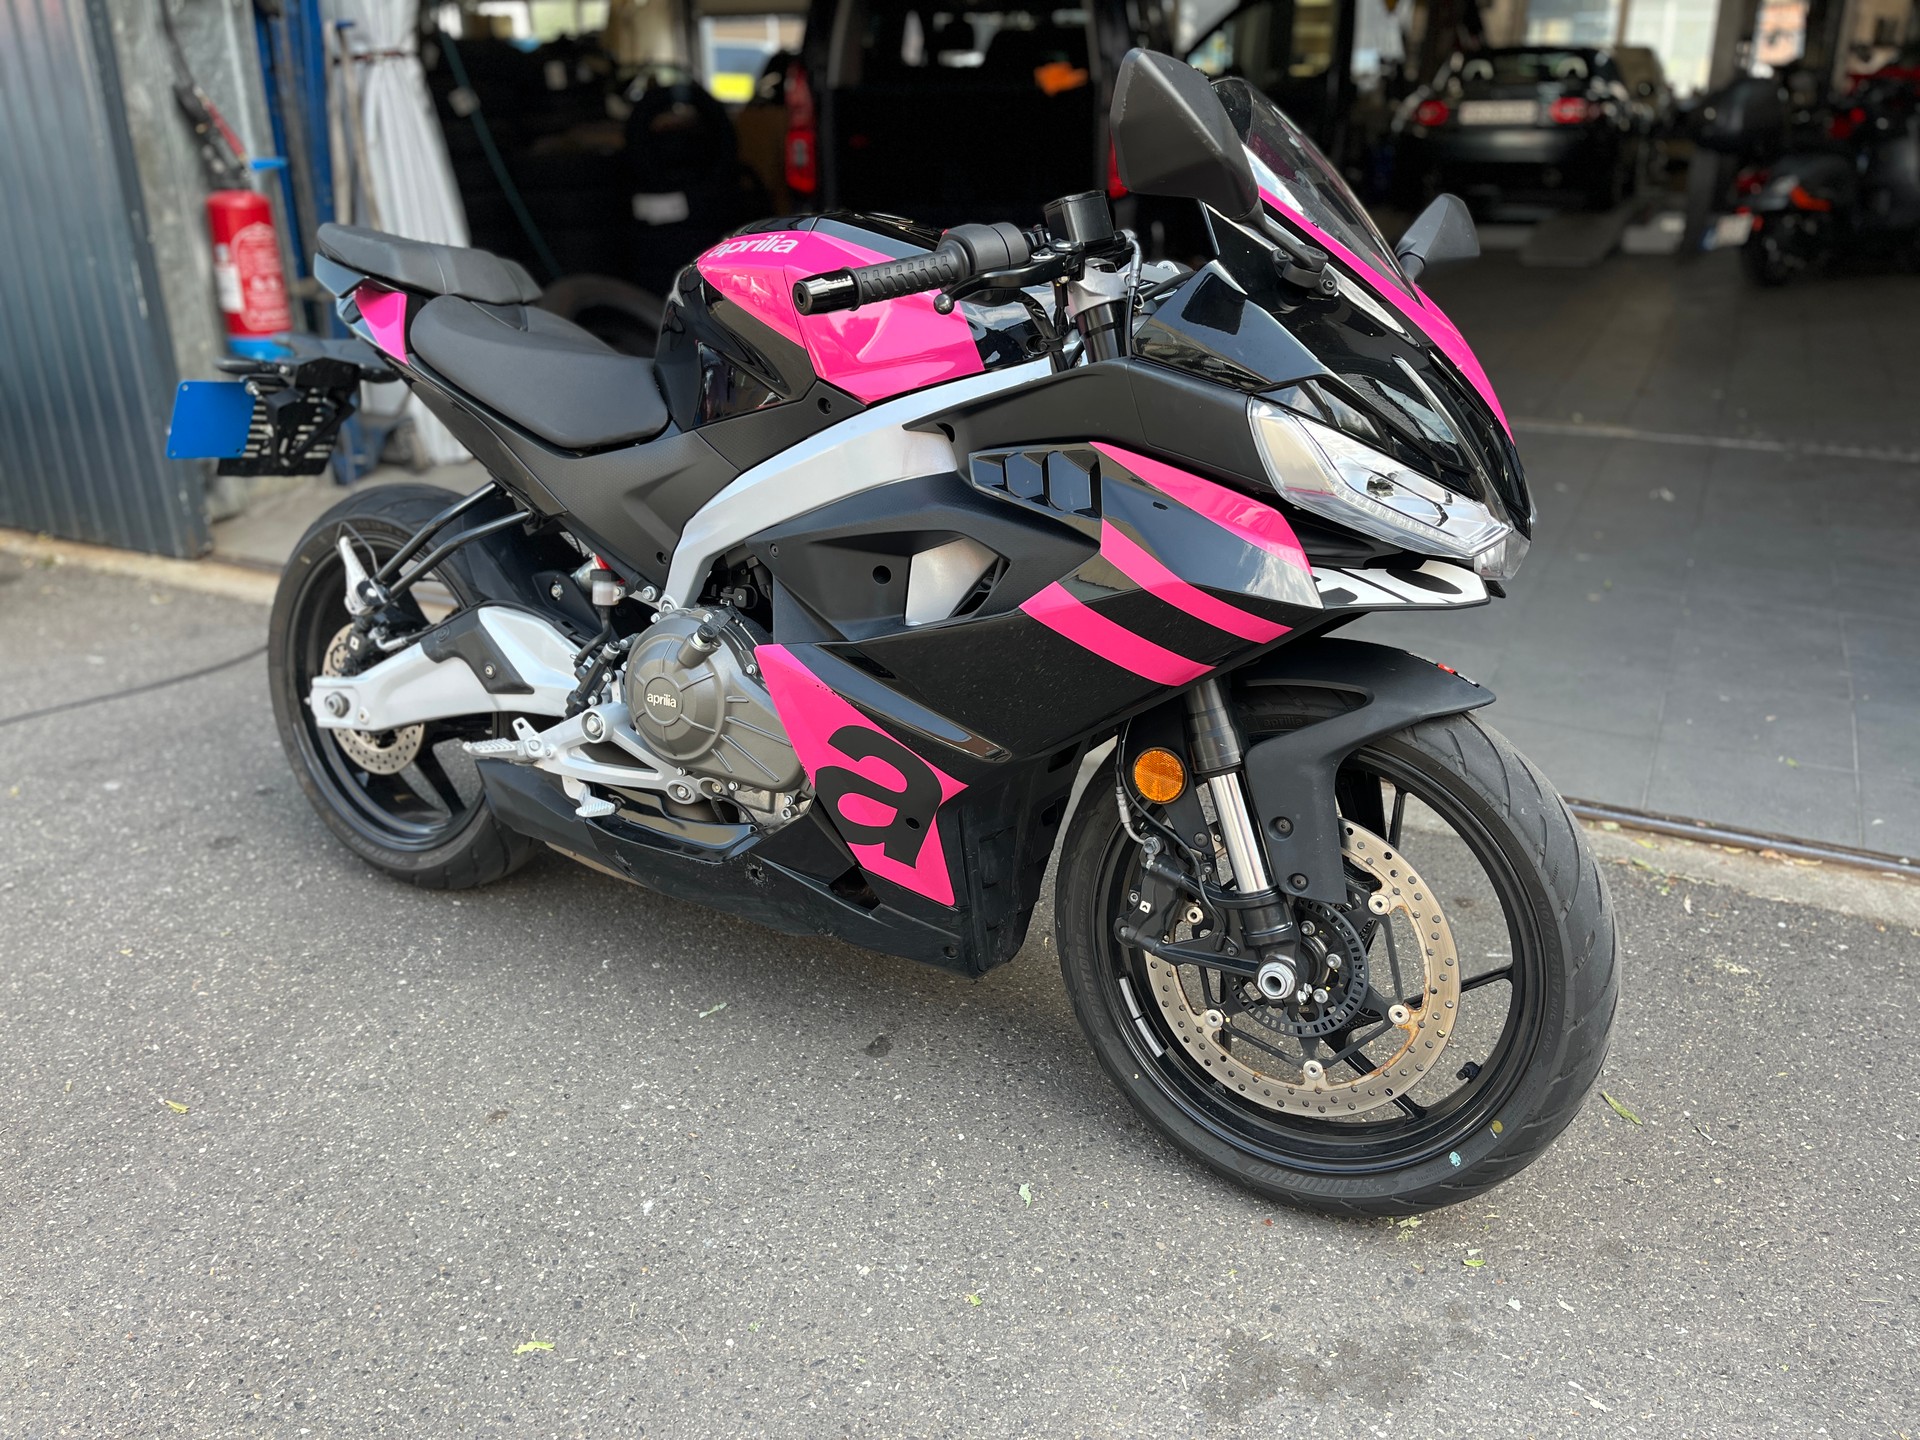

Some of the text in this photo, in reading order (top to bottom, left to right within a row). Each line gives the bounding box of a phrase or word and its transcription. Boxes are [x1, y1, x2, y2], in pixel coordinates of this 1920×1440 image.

[708, 234, 799, 259] aprilia
[647, 692, 677, 709] aprilia
[816, 724, 943, 870] a
[1534, 896, 1558, 948] 110/70
